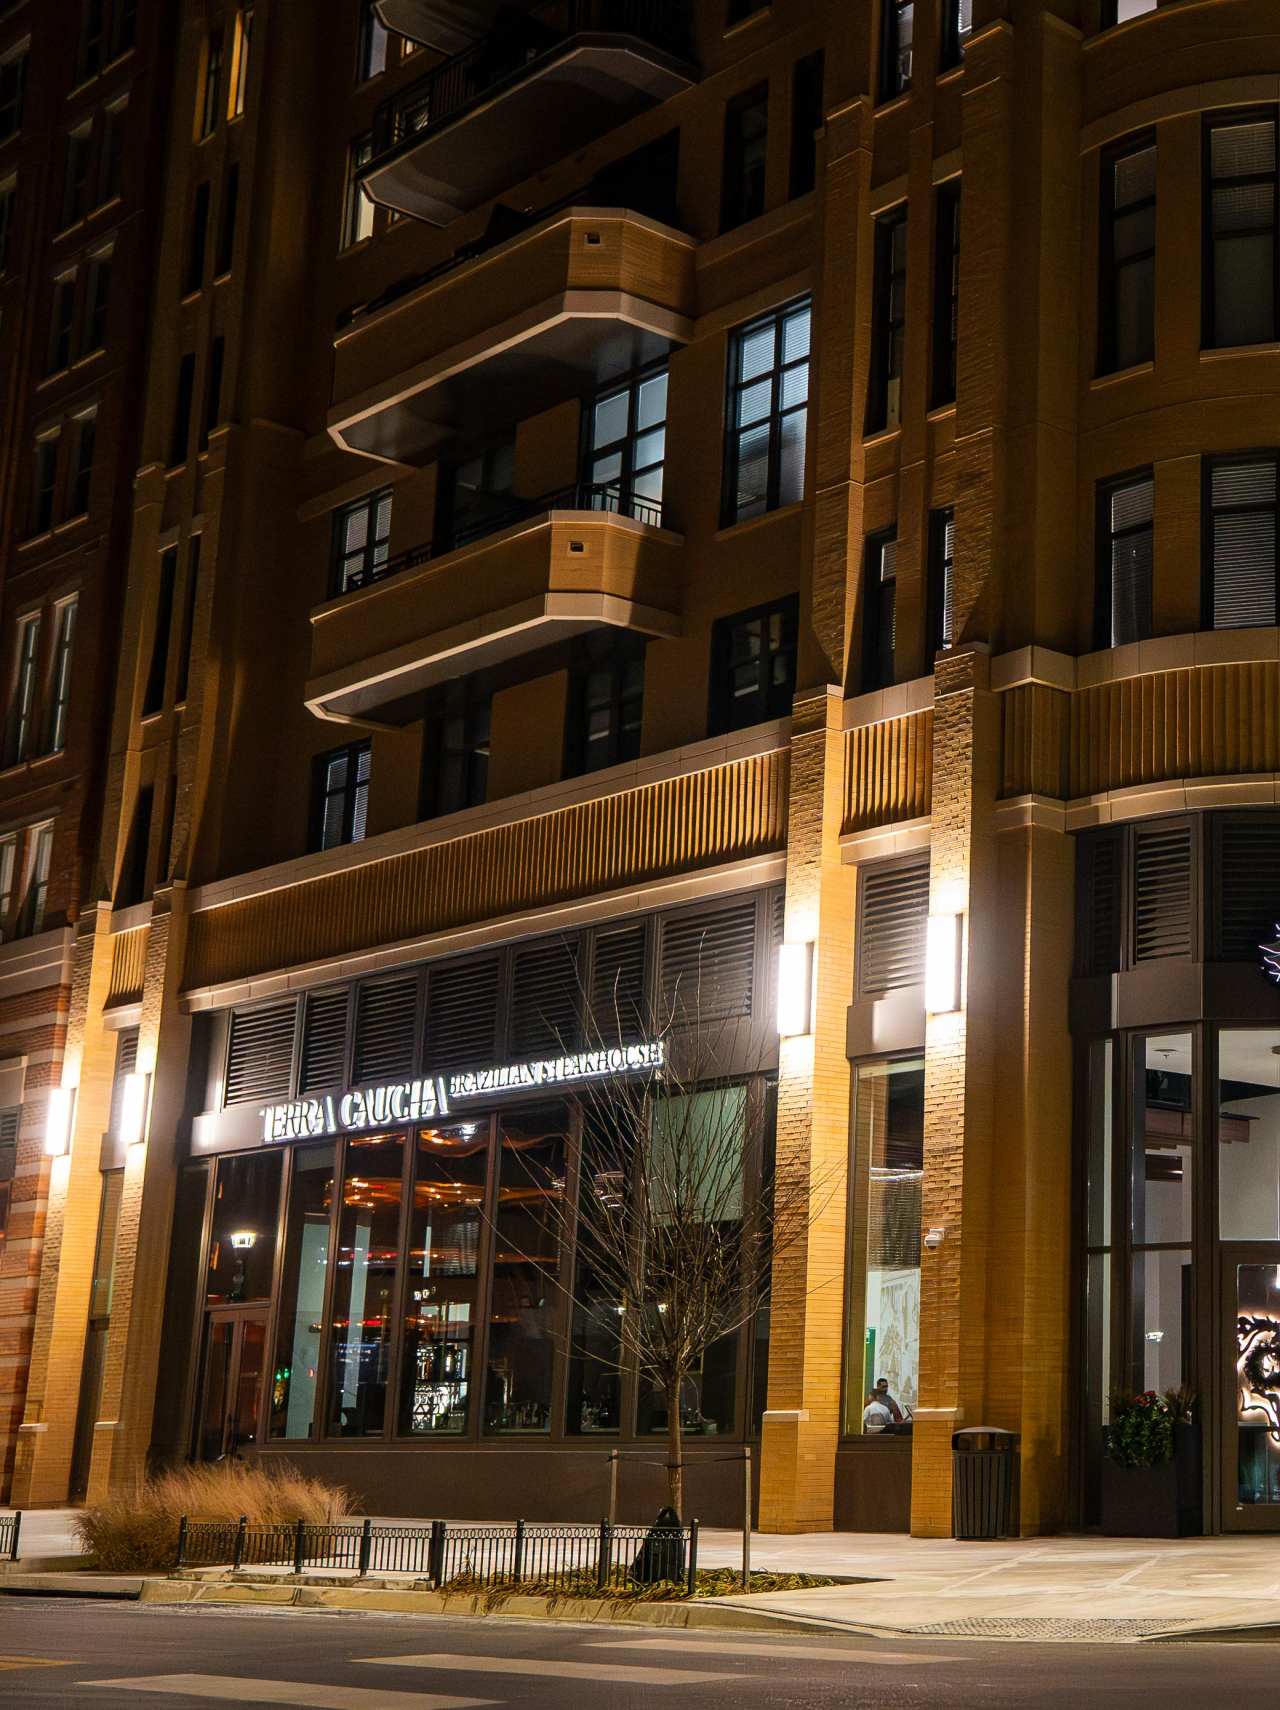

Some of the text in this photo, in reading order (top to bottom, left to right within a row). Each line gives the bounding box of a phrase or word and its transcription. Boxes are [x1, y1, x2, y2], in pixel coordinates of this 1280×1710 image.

[259, 1041, 664, 1142] TERRA GAUCHA BRAZILIAN STEAKHOUSE
